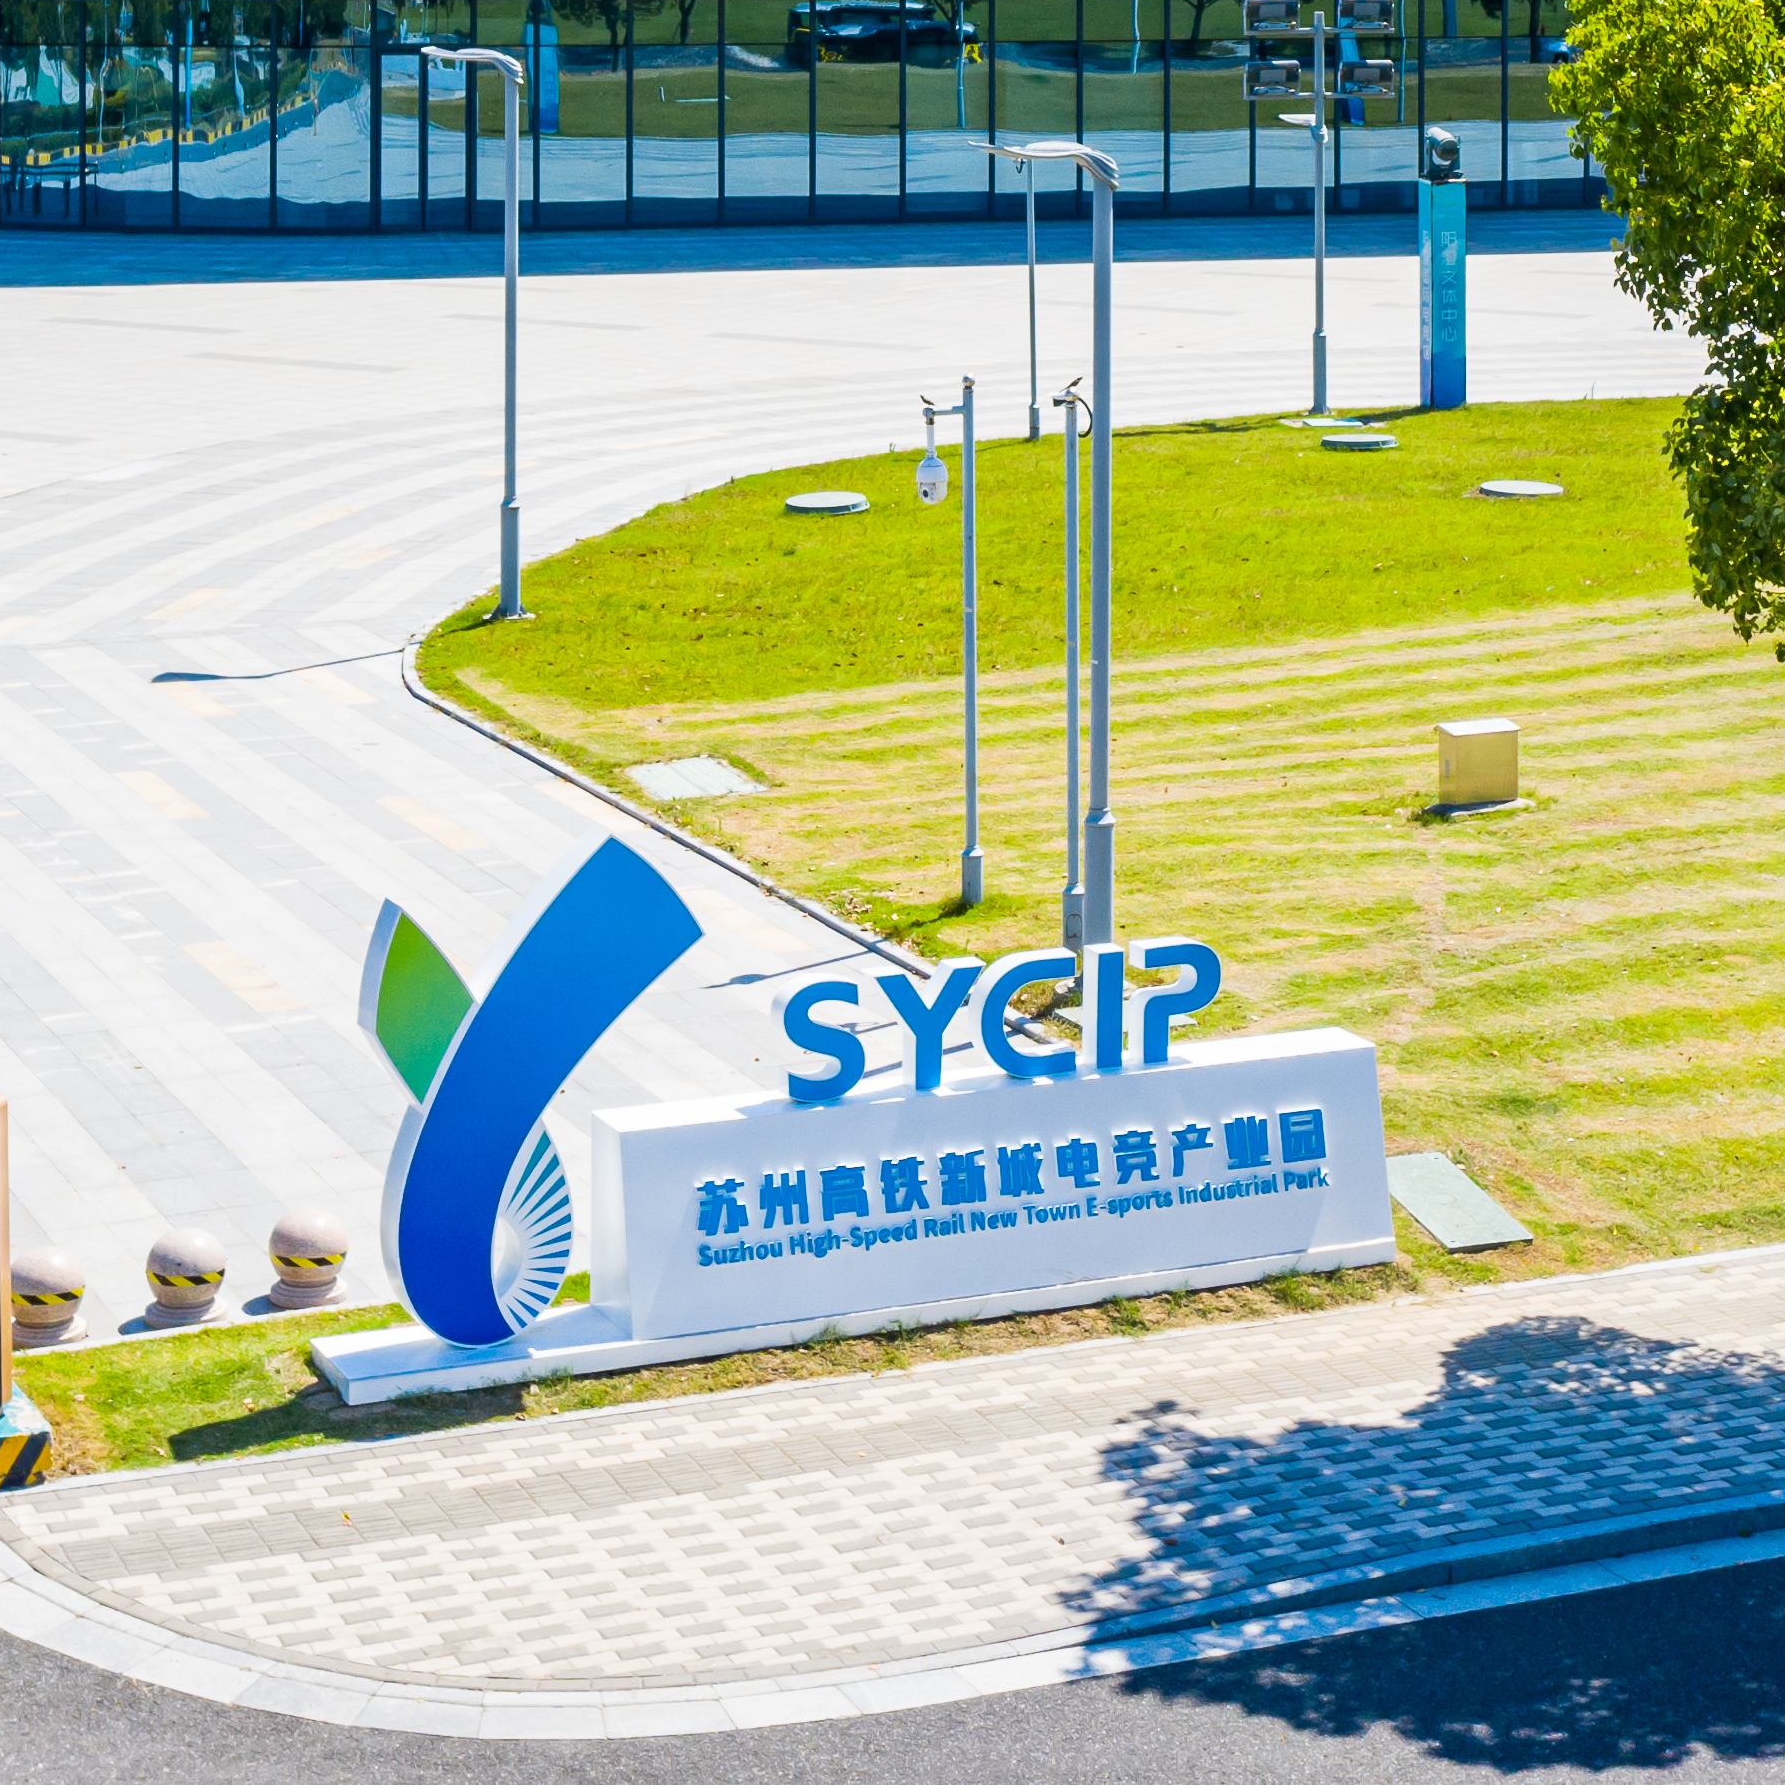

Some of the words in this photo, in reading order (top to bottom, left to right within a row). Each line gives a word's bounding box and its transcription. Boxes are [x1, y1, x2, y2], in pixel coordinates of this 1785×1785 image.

[774, 937, 1222, 1102] SYCIP
[696, 1109, 1327, 1236] 苏州高铁新城电竞产业园
[698, 1239, 783, 1267] Suzhou
[789, 1218, 918, 1258] High-Speed
[924, 1213, 965, 1238] Rail
[970, 1210, 1017, 1232] New
[1023, 1204, 1081, 1226] Town
[1086, 1190, 1174, 1218] E-sports
[1179, 1172, 1278, 1204] Industrial
[1283, 1167, 1330, 1192] Park
